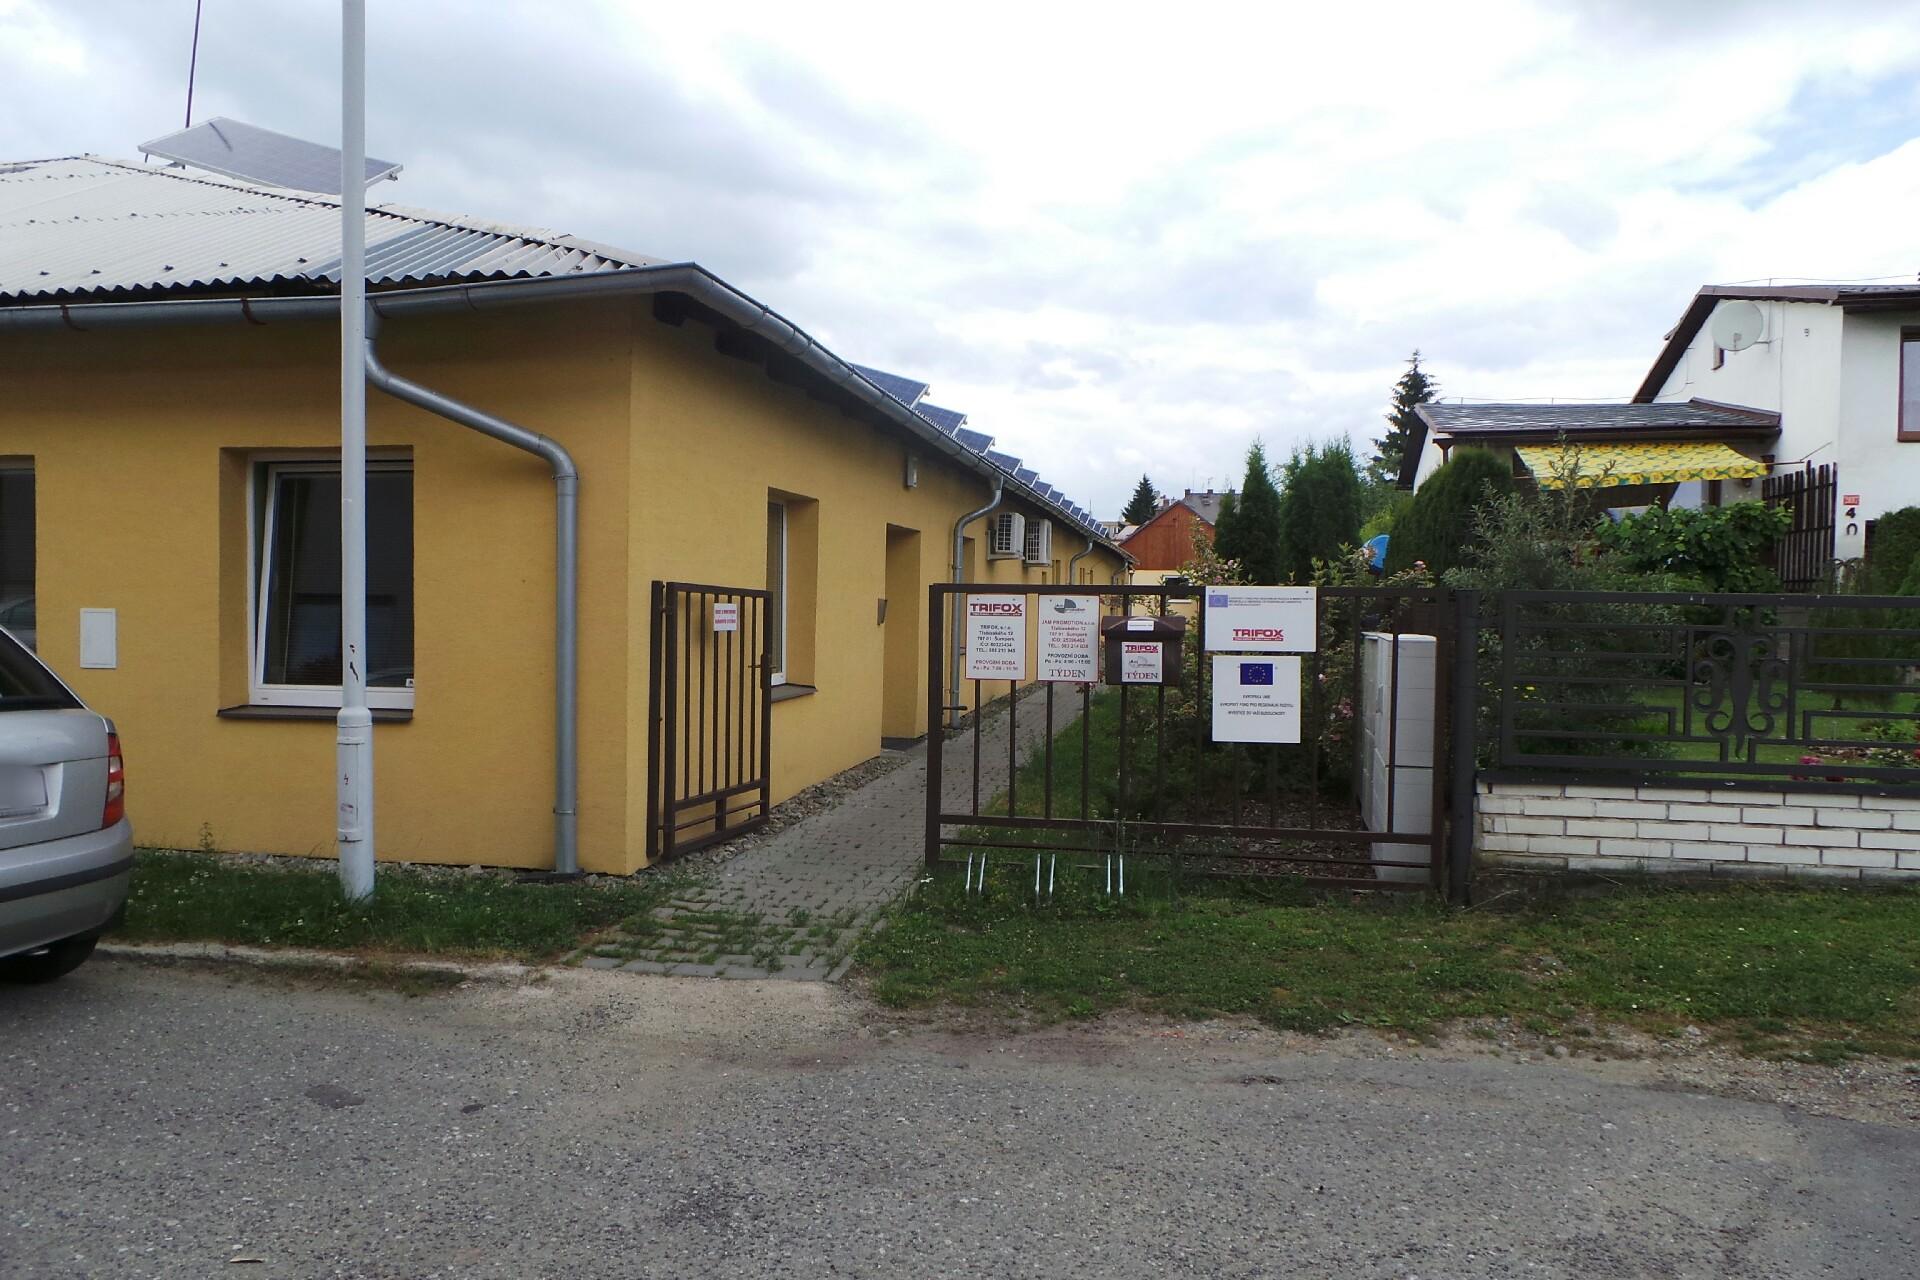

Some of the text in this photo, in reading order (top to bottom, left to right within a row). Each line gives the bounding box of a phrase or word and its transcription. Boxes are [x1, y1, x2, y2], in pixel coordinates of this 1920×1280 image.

[1845, 507, 1856, 518] 4
[970, 603, 1022, 612] TRIFOX
[1233, 629, 1284, 638] TRIFOX
[1049, 667, 1086, 678] TÝDEN
[1125, 670, 1159, 680] TÝDEN
